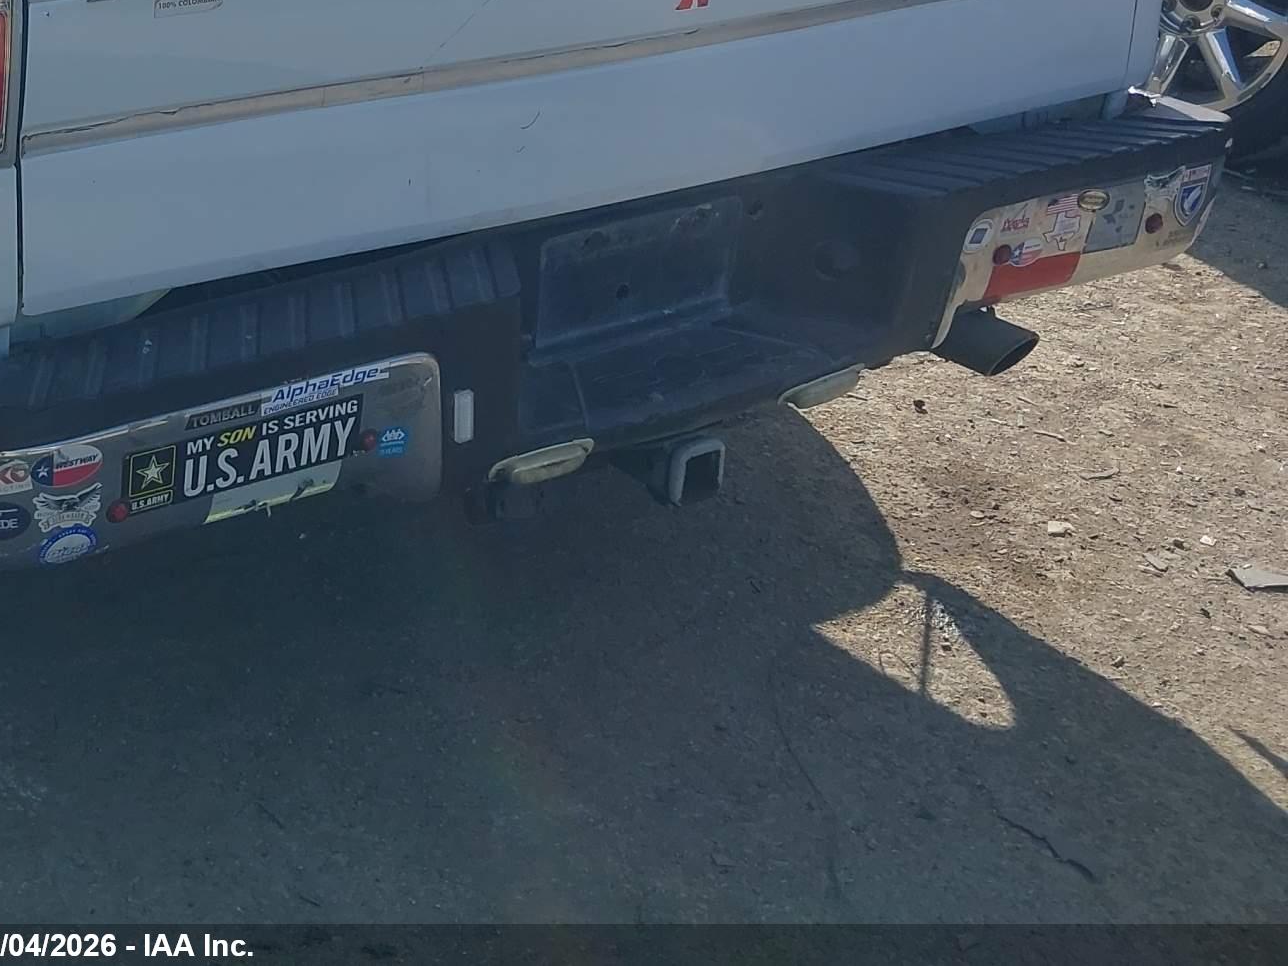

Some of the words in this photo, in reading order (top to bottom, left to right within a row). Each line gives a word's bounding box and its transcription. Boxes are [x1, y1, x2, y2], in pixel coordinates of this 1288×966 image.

[158, 0, 177, 10] 100%
[272, 367, 380, 403] AlphaEdge
[264, 395, 315, 415] ENGINEERED
[316, 388, 338, 401] EDGE
[187, 436, 216, 456] MY
[217, 425, 257, 448] SON
[262, 419, 280, 436] IS
[283, 399, 359, 431] SERVING
[191, 405, 256, 428] TOMBALL
